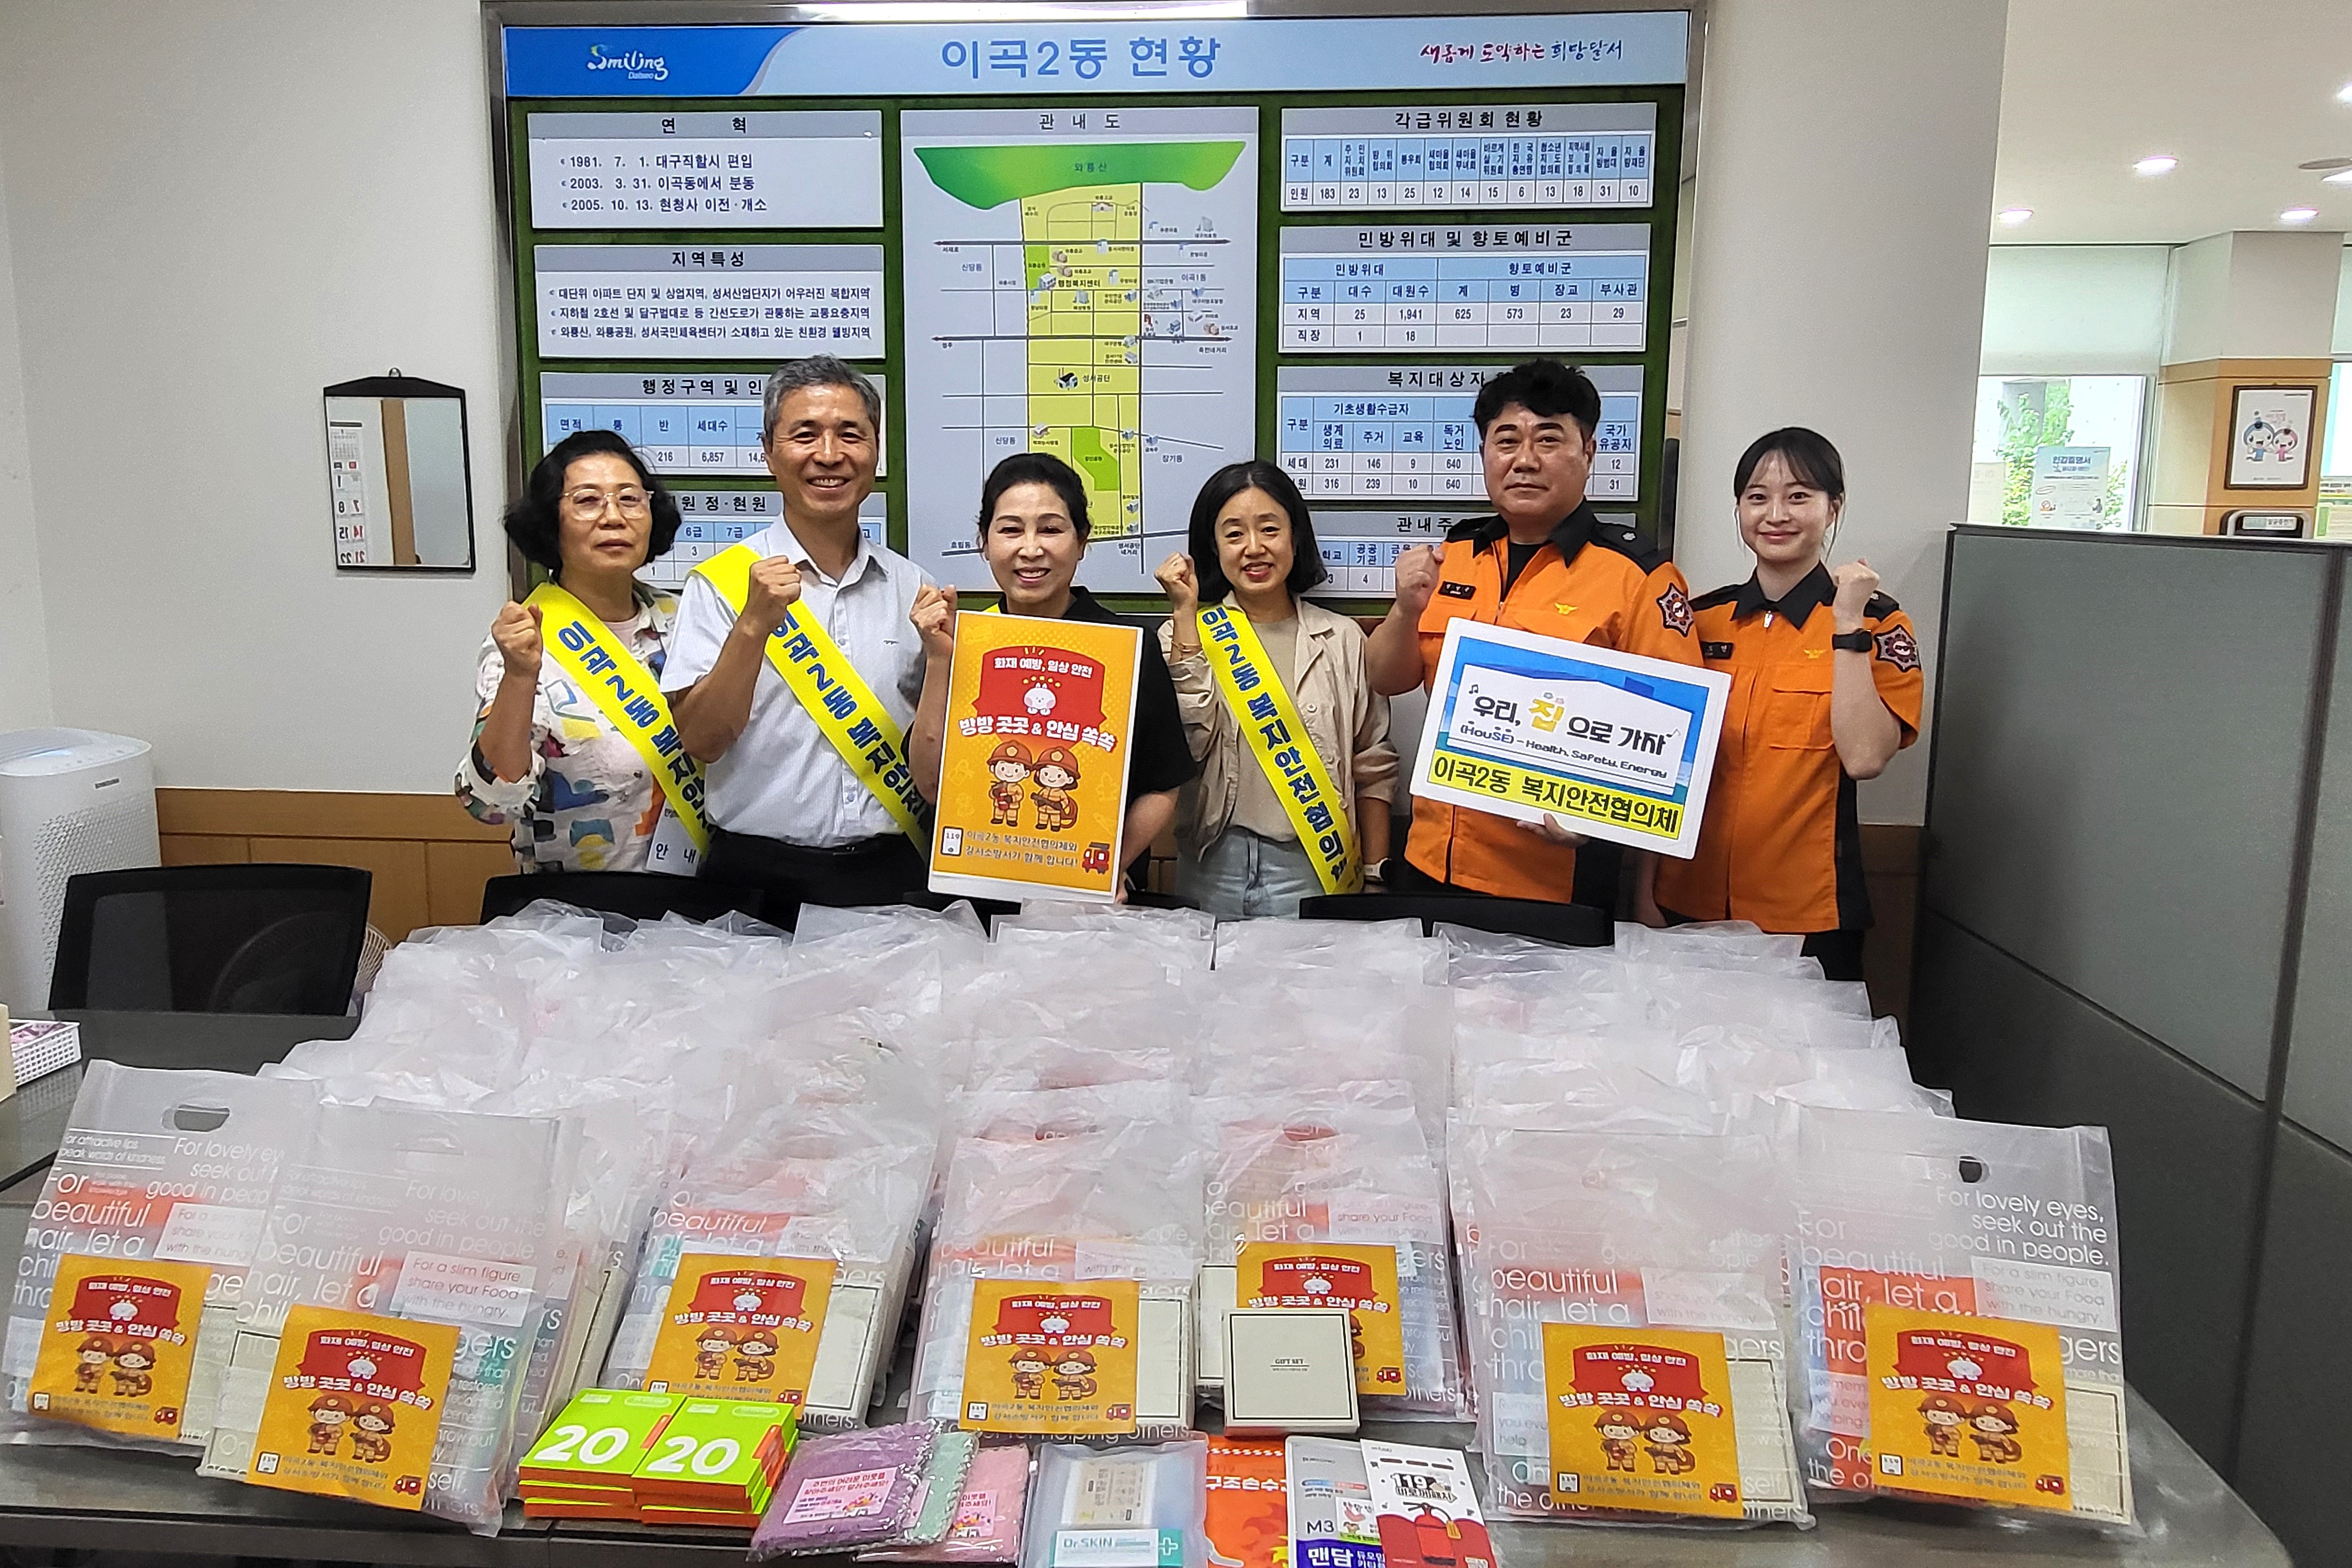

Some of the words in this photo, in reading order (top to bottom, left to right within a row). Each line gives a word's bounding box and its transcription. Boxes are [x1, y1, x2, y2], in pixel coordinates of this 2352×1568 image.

[942, 39, 1107, 79] 이곡2동
[1129, 36, 1221, 79] 현황
[1421, 44, 1474, 63] 새롭게
[1481, 43, 1545, 63] 도약하는
[1551, 41, 1623, 61] 희망달서
[587, 44, 669, 80] Smiling
[1395, 112, 1494, 129] 각급위원회
[1505, 111, 1542, 128] 현황
[570, 155, 602, 168] 1981.
[614, 156, 626, 168] 7.
[639, 156, 650, 168] 1.
[656, 154, 720, 168] 대구직할시
[727, 154, 753, 168] 편입
[1291, 154, 1309, 168] 구분
[570, 178, 603, 189] 2003.
[616, 178, 627, 189] 3.
[633, 178, 651, 189] 31.
[658, 177, 722, 190] 이곡동에서
[729, 177, 754, 190] 분동
[1291, 186, 1308, 200] 인원
[1319, 186, 1335, 200] 183
[1349, 186, 1359, 199] 23
[571, 199, 604, 211] 2005.
[611, 199, 629, 210] 10.
[636, 199, 653, 210] 13.
[659, 198, 698, 212] 현청사
[1358, 231, 1435, 247] 민방위대
[1446, 231, 1461, 247] 및
[1472, 230, 1572, 246] 향토예비군
[672, 252, 744, 267] 지역특성
[1335, 264, 1384, 276] 민방위대
[1509, 263, 1572, 275] 향토예비군
[559, 287, 587, 299] 대단위
[627, 287, 646, 299] 단지
[651, 287, 660, 299] 및
[786, 287, 824, 299] 어우러진
[830, 287, 870, 299] 복합지역
[1348, 285, 1372, 298] 대수
[1393, 285, 1429, 298] 대원수
[1555, 285, 1578, 297] 장교
[1600, 283, 1637, 296] 부사관
[593, 307, 619, 319] 2호선
[625, 307, 633, 319] 및
[694, 307, 703, 319] 등
[709, 307, 760, 319] 간선도로가
[1298, 307, 1321, 320] 지역
[1355, 309, 1365, 320] 25
[1399, 308, 1422, 320] 1,941
[1455, 308, 1471, 319] 625
[731, 326, 770, 338] 소재하고
[774, 326, 793, 338] 있는
[798, 326, 826, 338] 친환경
[1297, 329, 1320, 342] 직장
[1388, 372, 1485, 387] 복지대상자
[643, 380, 714, 395] 행정구역
[725, 380, 738, 396] 및
[1287, 419, 1308, 431] 구분
[1334, 403, 1409, 415] 기초생활수급자
[697, 420, 728, 432] 세대수
[1324, 424, 1343, 436] 생계
[1363, 431, 1383, 443] 주거
[1403, 430, 1424, 443] 교육
[1444, 423, 1464, 436] 독거
[1605, 423, 1626, 436] 국가
[1323, 437, 1343, 450] 의료
[1444, 437, 1464, 450] 노인
[1599, 437, 1631, 451] 유공자
[702, 452, 724, 463] 6,857
[1287, 457, 1308, 470] 세대
[1325, 458, 1339, 469] 231
[686, 527, 703, 539] 6급
[1357, 544, 1377, 556] 공공
[1356, 553, 1377, 564] 기관
[1202, 607, 1260, 691] 이곡2동
[559, 621, 661, 728] 이곡2동
[994, 657, 1017, 669] 화재
[1020, 658, 1045, 672] 예방,
[1048, 661, 1069, 673] 일상
[1071, 664, 1093, 678] 안전
[1474, 696, 1521, 726] 우리,
[1529, 696, 1565, 732] 집
[1567, 716, 1613, 744] 으로
[1618, 726, 1666, 756] 가자
[959, 717, 994, 737] 방방
[997, 717, 1029, 734] 곳곳
[1031, 723, 1041, 735] &
[1047, 720, 1078, 741] 안심
[1081, 726, 1117, 753] 쏙쏙
[1434, 755, 1511, 794] 이곡2동
[1522, 776, 1678, 833] 복지안전협의체
[31, 1199, 151, 1228] beautiful
[1976, 1190, 2040, 1218] lovely
[2047, 1201, 2104, 1222] eyes,
[1971, 1215, 2024, 1235] seek
[2030, 1219, 2064, 1238] out
[2071, 1222, 2107, 1243] the
[1929, 1232, 1990, 1251] good
[1997, 1236, 2014, 1254] in
[2023, 1241, 2109, 1266] people.
[450, 1265, 476, 1276] slim
[407, 1277, 443, 1290] share
[449, 1282, 479, 1293] your
[482, 1285, 518, 1300] Food
[1491, 1268, 1618, 1294] beautiful
[1560, 1298, 1597, 1322] let
[1609, 1302, 1630, 1323] a
[533, 1425, 629, 1465] 20
[647, 1436, 740, 1475] 20
[1391, 1473, 1427, 1489] 119
[1307, 1520, 1334, 1534] M3
[1308, 1546, 1354, 1566] 맨담
